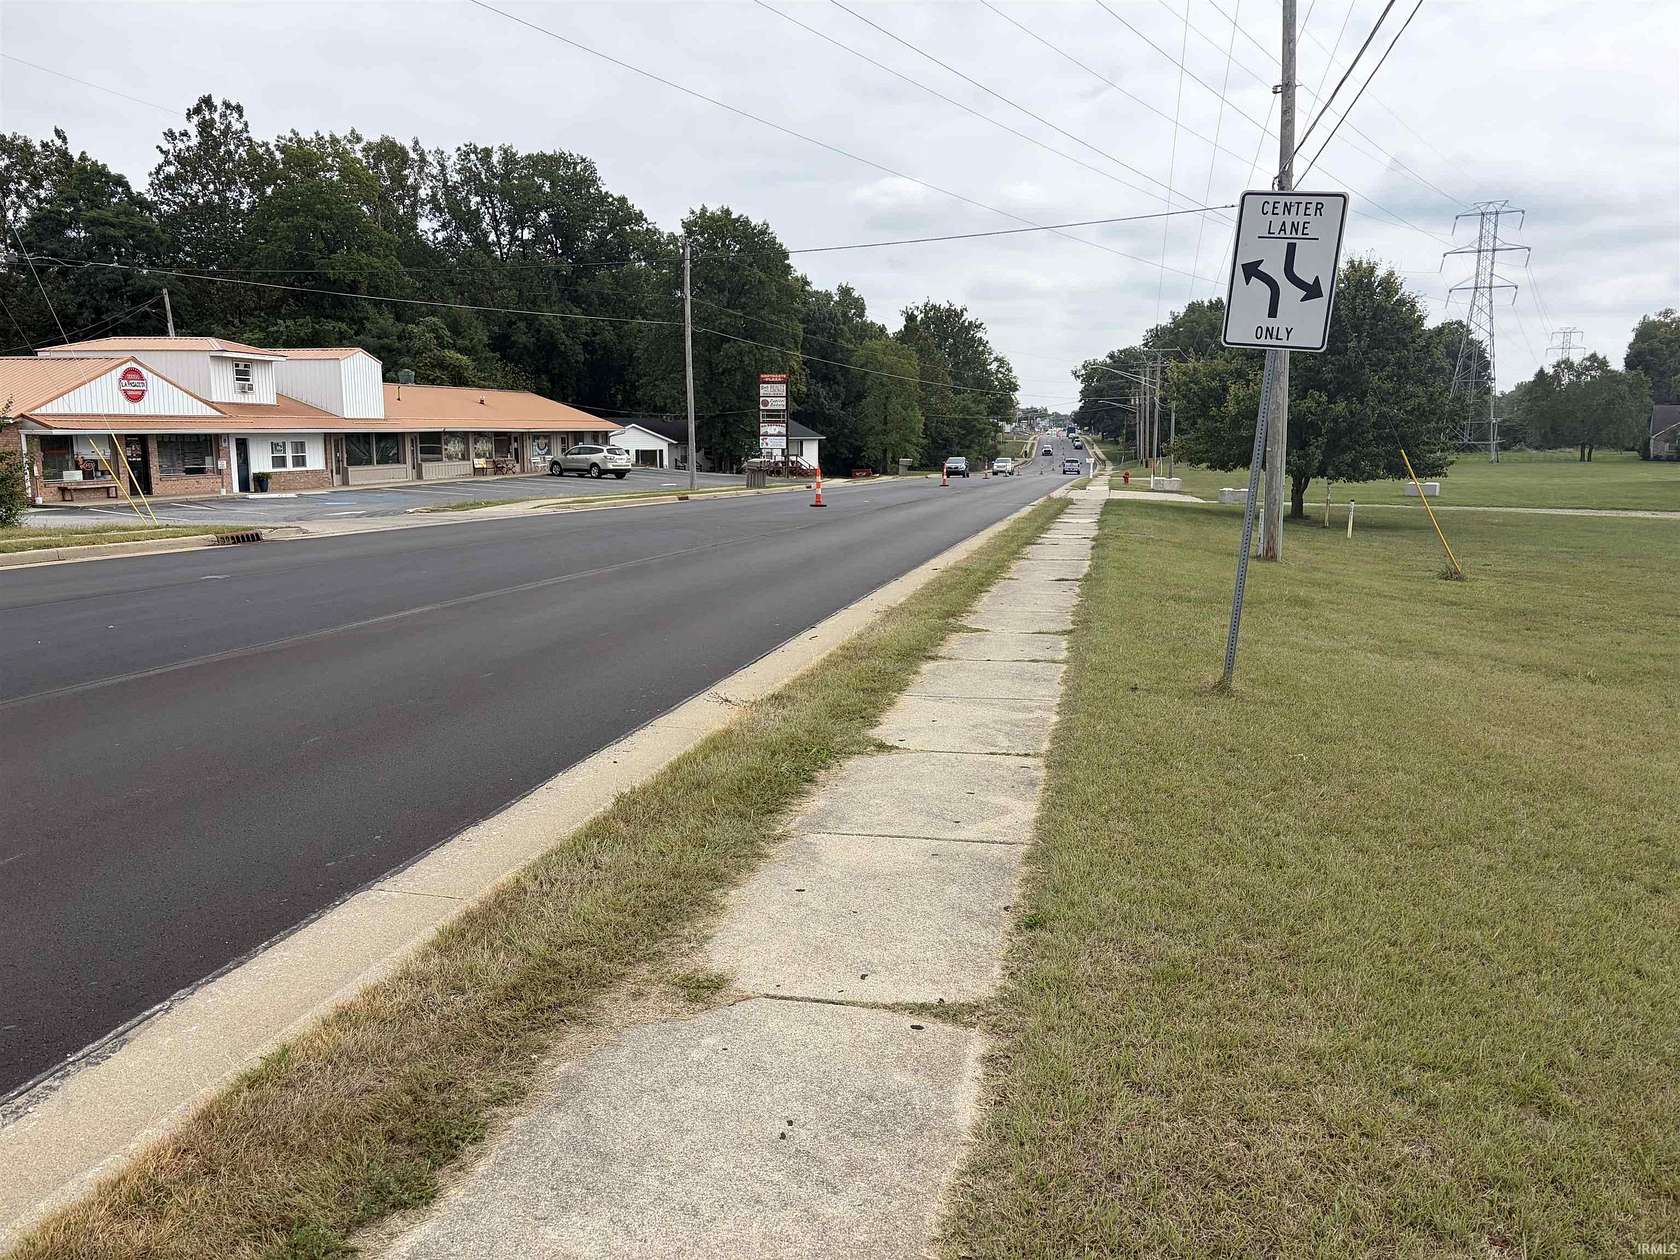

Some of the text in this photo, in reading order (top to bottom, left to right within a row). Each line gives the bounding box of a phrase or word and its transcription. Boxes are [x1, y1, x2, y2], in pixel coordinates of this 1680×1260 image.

[1261, 200, 1324, 217] CENTER
[1267, 220, 1311, 236] LANE
[1255, 325, 1294, 341] ONLY
